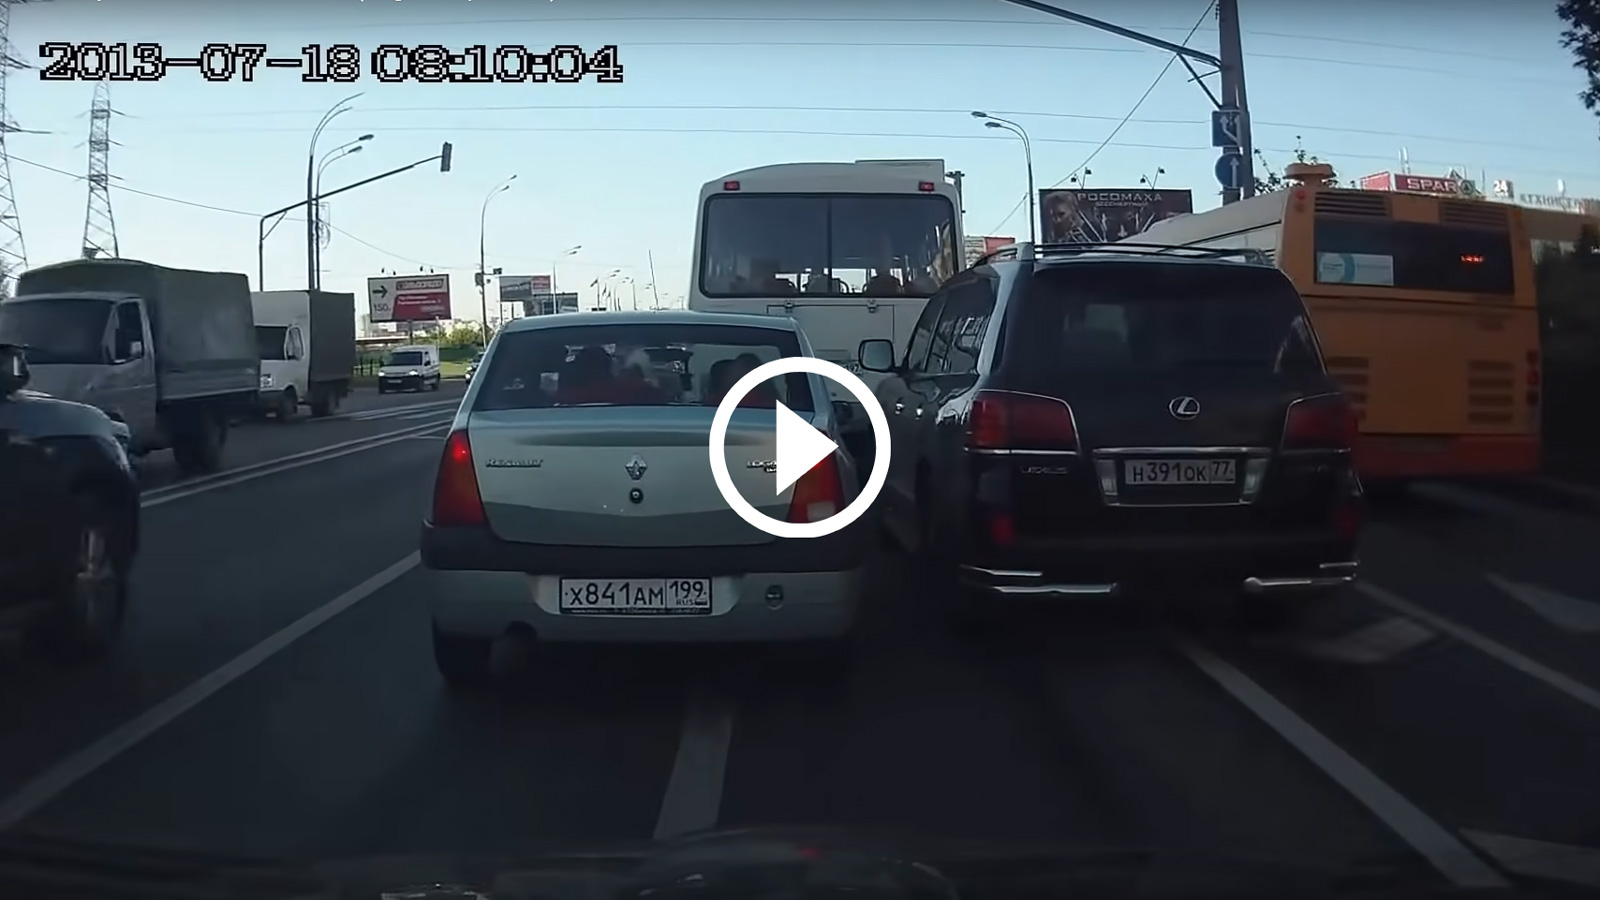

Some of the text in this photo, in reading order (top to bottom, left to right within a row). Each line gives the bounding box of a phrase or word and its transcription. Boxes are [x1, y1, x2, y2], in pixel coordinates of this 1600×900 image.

[1407, 178, 1457, 193] SPAR
[1077, 192, 1162, 202] РОСОМАХА
[1133, 461, 1229, 482] Н391ОК 77
[570, 580, 704, 606] Х841АМ 199
